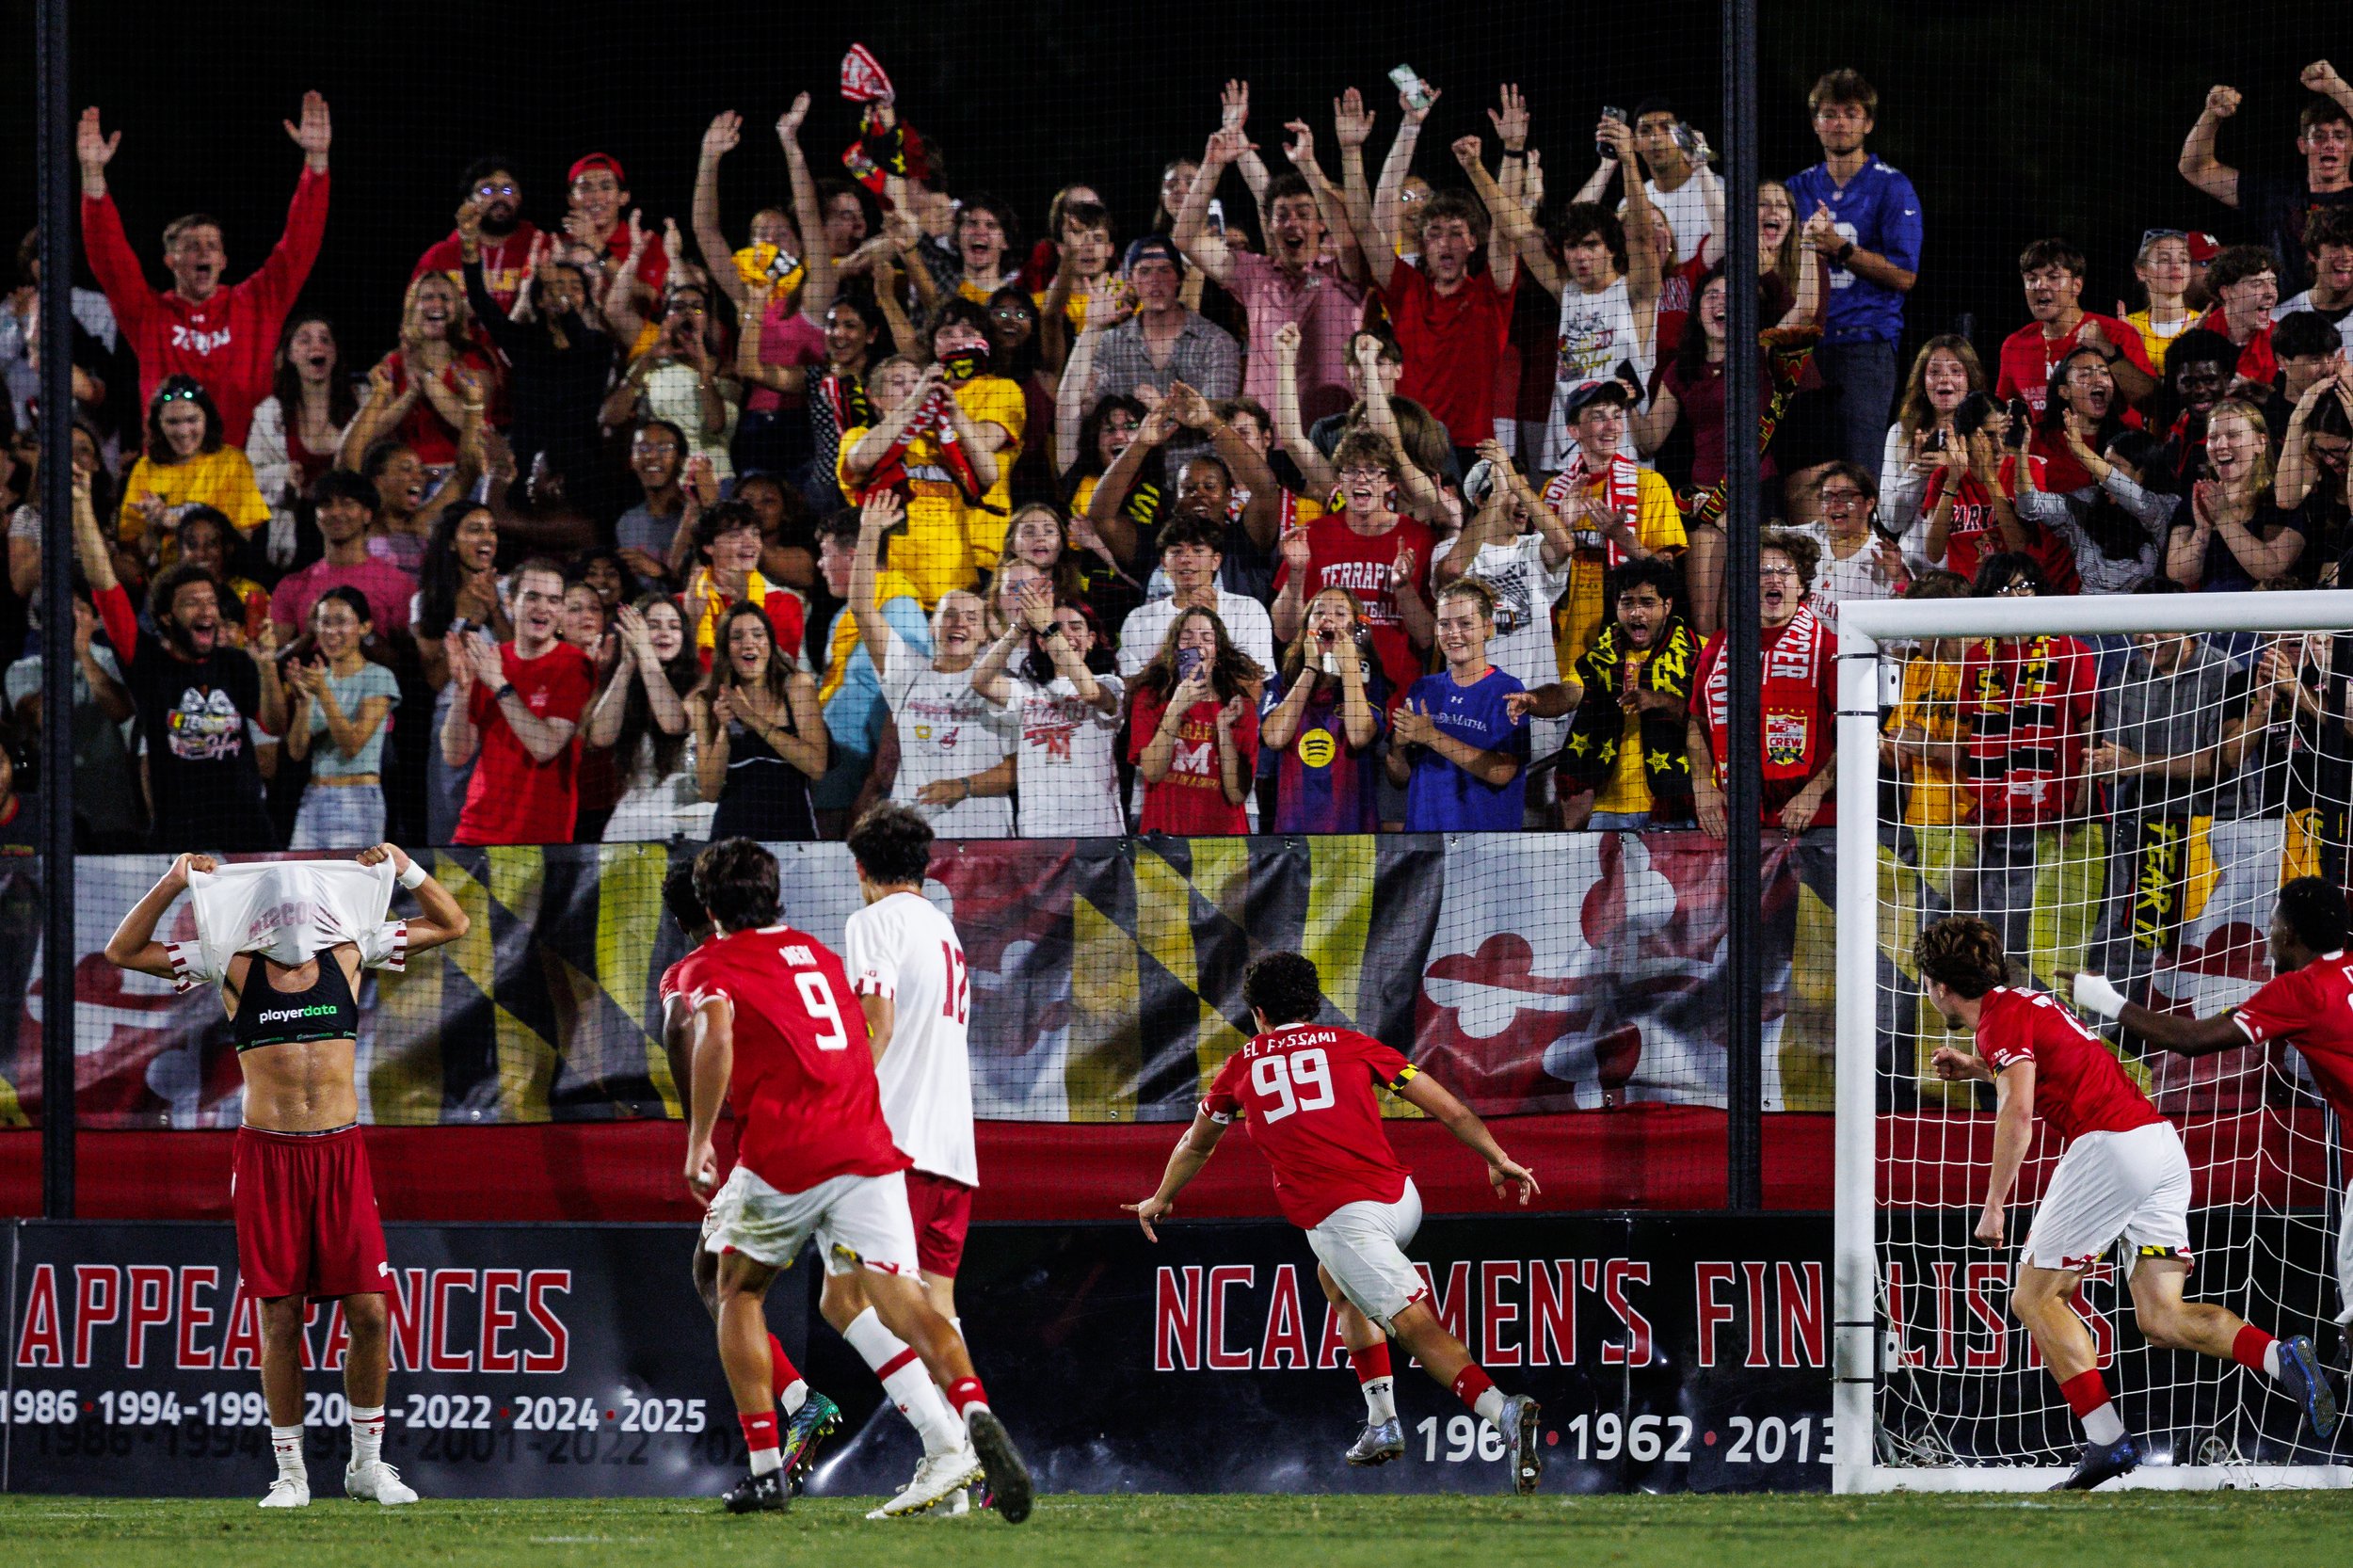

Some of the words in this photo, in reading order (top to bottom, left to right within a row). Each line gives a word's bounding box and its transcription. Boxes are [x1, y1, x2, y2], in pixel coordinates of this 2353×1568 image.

[1770, 605, 1814, 680] SOCCER
[1172, 738, 1213, 775] M
[1769, 737, 1802, 747] CREW
[259, 1004, 338, 1024] playerdata
[794, 970, 848, 1051] 9
[941, 939, 968, 1025] 12
[1243, 1040, 1259, 1059] EL
[1251, 1048, 1336, 1125] 99
[1409, 1257, 1652, 1368] MEN'S
[1695, 1260, 2114, 1369] FINLISS
[512, 1395, 600, 1432] 2024
[619, 1398, 707, 1432] 2025
[1416, 1414, 1538, 1463] 196
[1567, 1411, 1693, 1463] 1962
